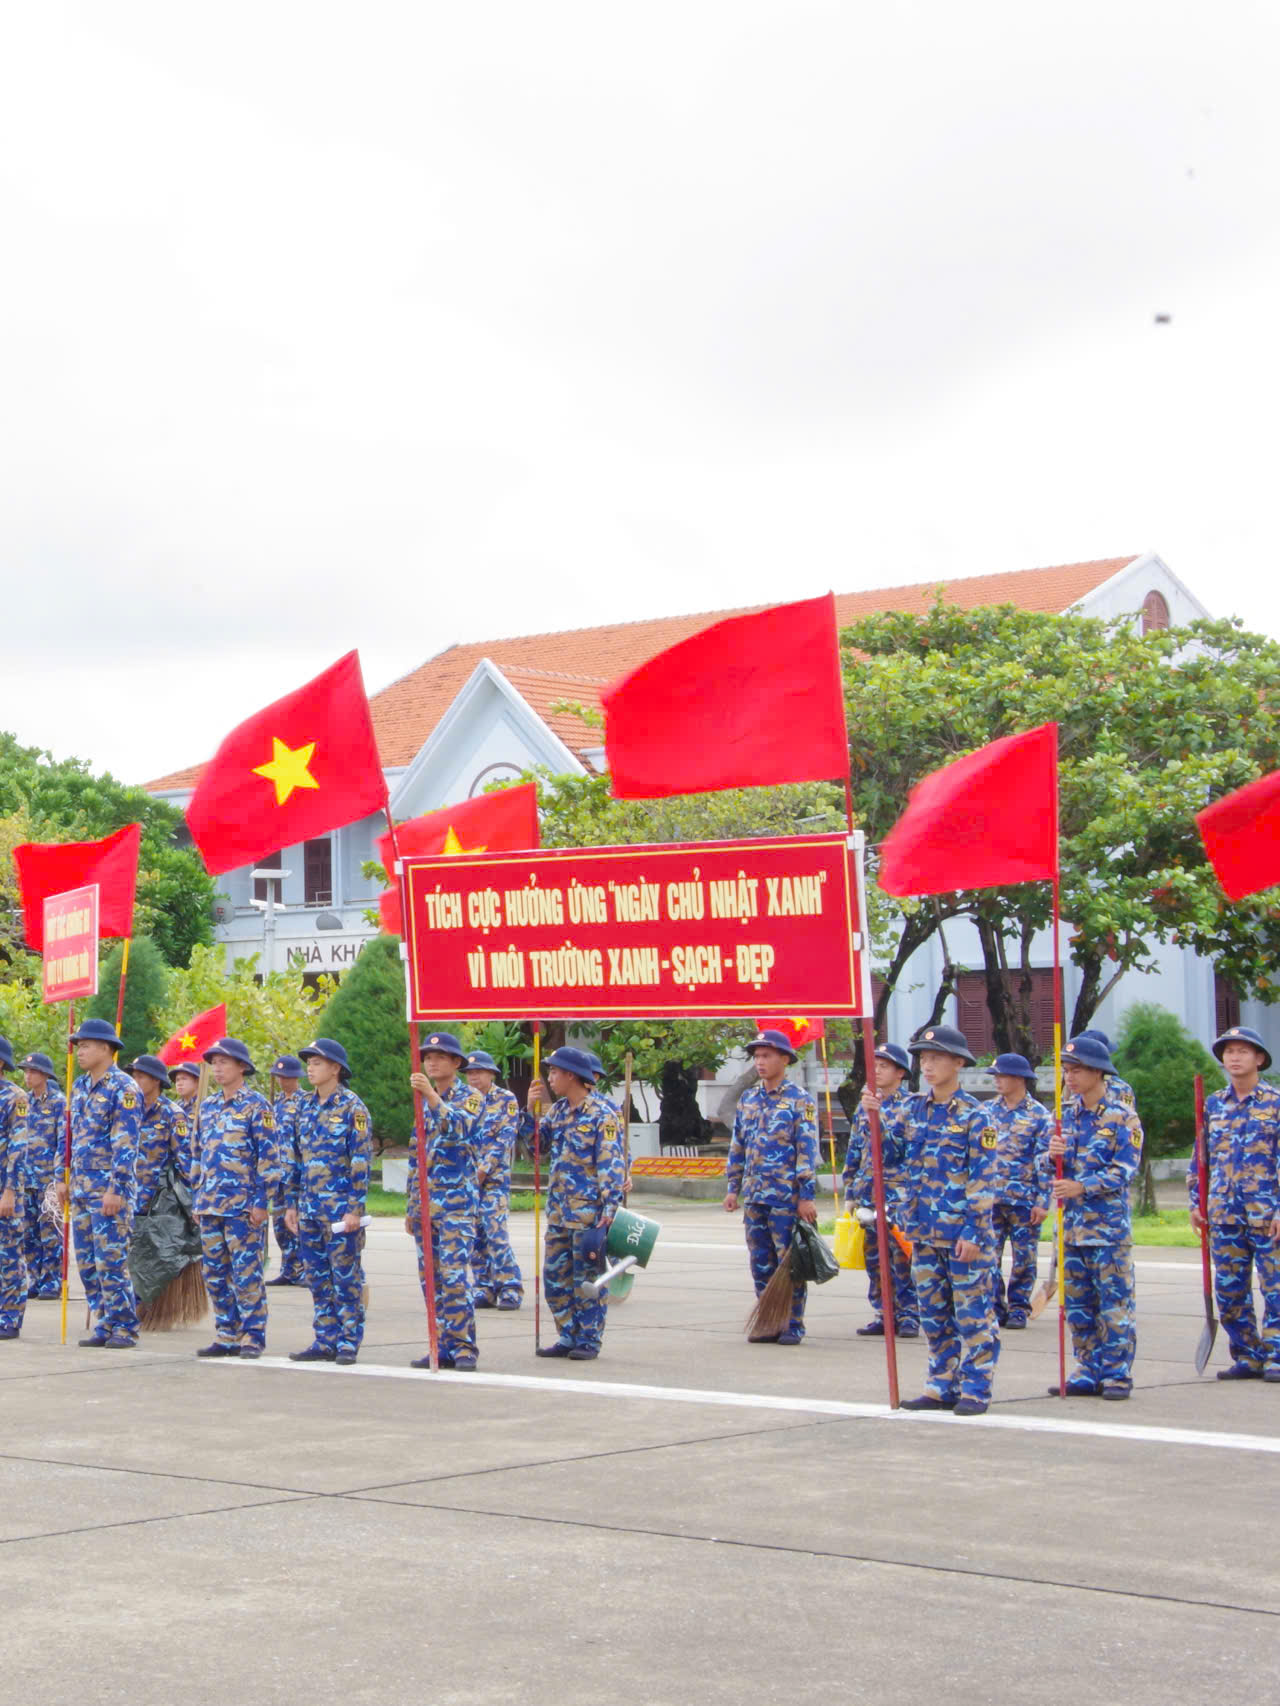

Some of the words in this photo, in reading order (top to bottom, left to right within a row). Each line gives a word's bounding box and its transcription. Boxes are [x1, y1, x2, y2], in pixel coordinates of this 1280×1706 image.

[424, 884, 464, 930] TÍCH
[467, 887, 502, 935] CỰC
[504, 872, 565, 927] HƯỞNG
[567, 877, 608, 925] ỨNG
[666, 867, 705, 921] CHỦ
[710, 870, 759, 925] NHẬT
[286, 939, 323, 963] NHÀ
[467, 944, 487, 988] VÌ
[490, 944, 525, 988] MÔI
[529, 940, 604, 987] TRƯỜNG
